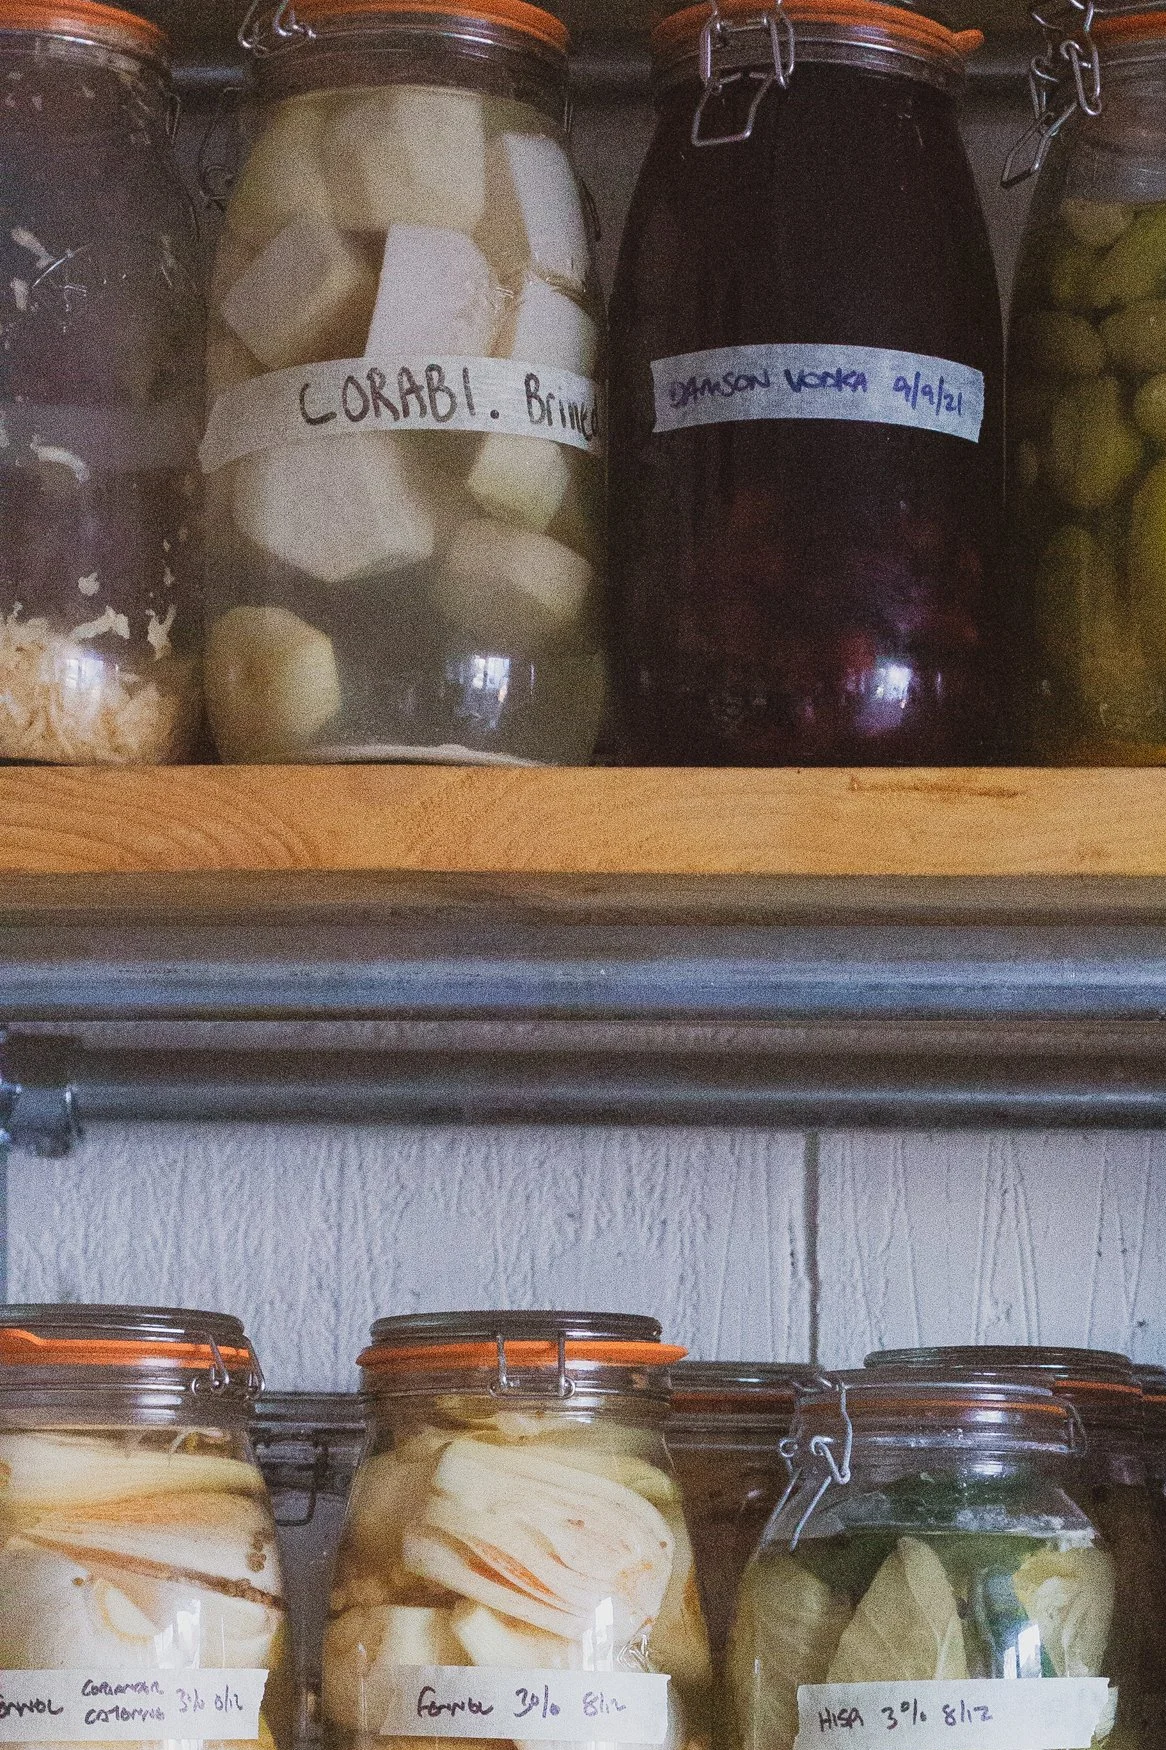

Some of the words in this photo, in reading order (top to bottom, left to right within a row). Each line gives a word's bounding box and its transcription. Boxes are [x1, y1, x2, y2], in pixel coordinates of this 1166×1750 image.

[784, 367, 868, 393] VODKA
[514, 1685, 561, 1718] 3%
[881, 1699, 928, 1730] 3%
[943, 1700, 993, 1727] 8/12
